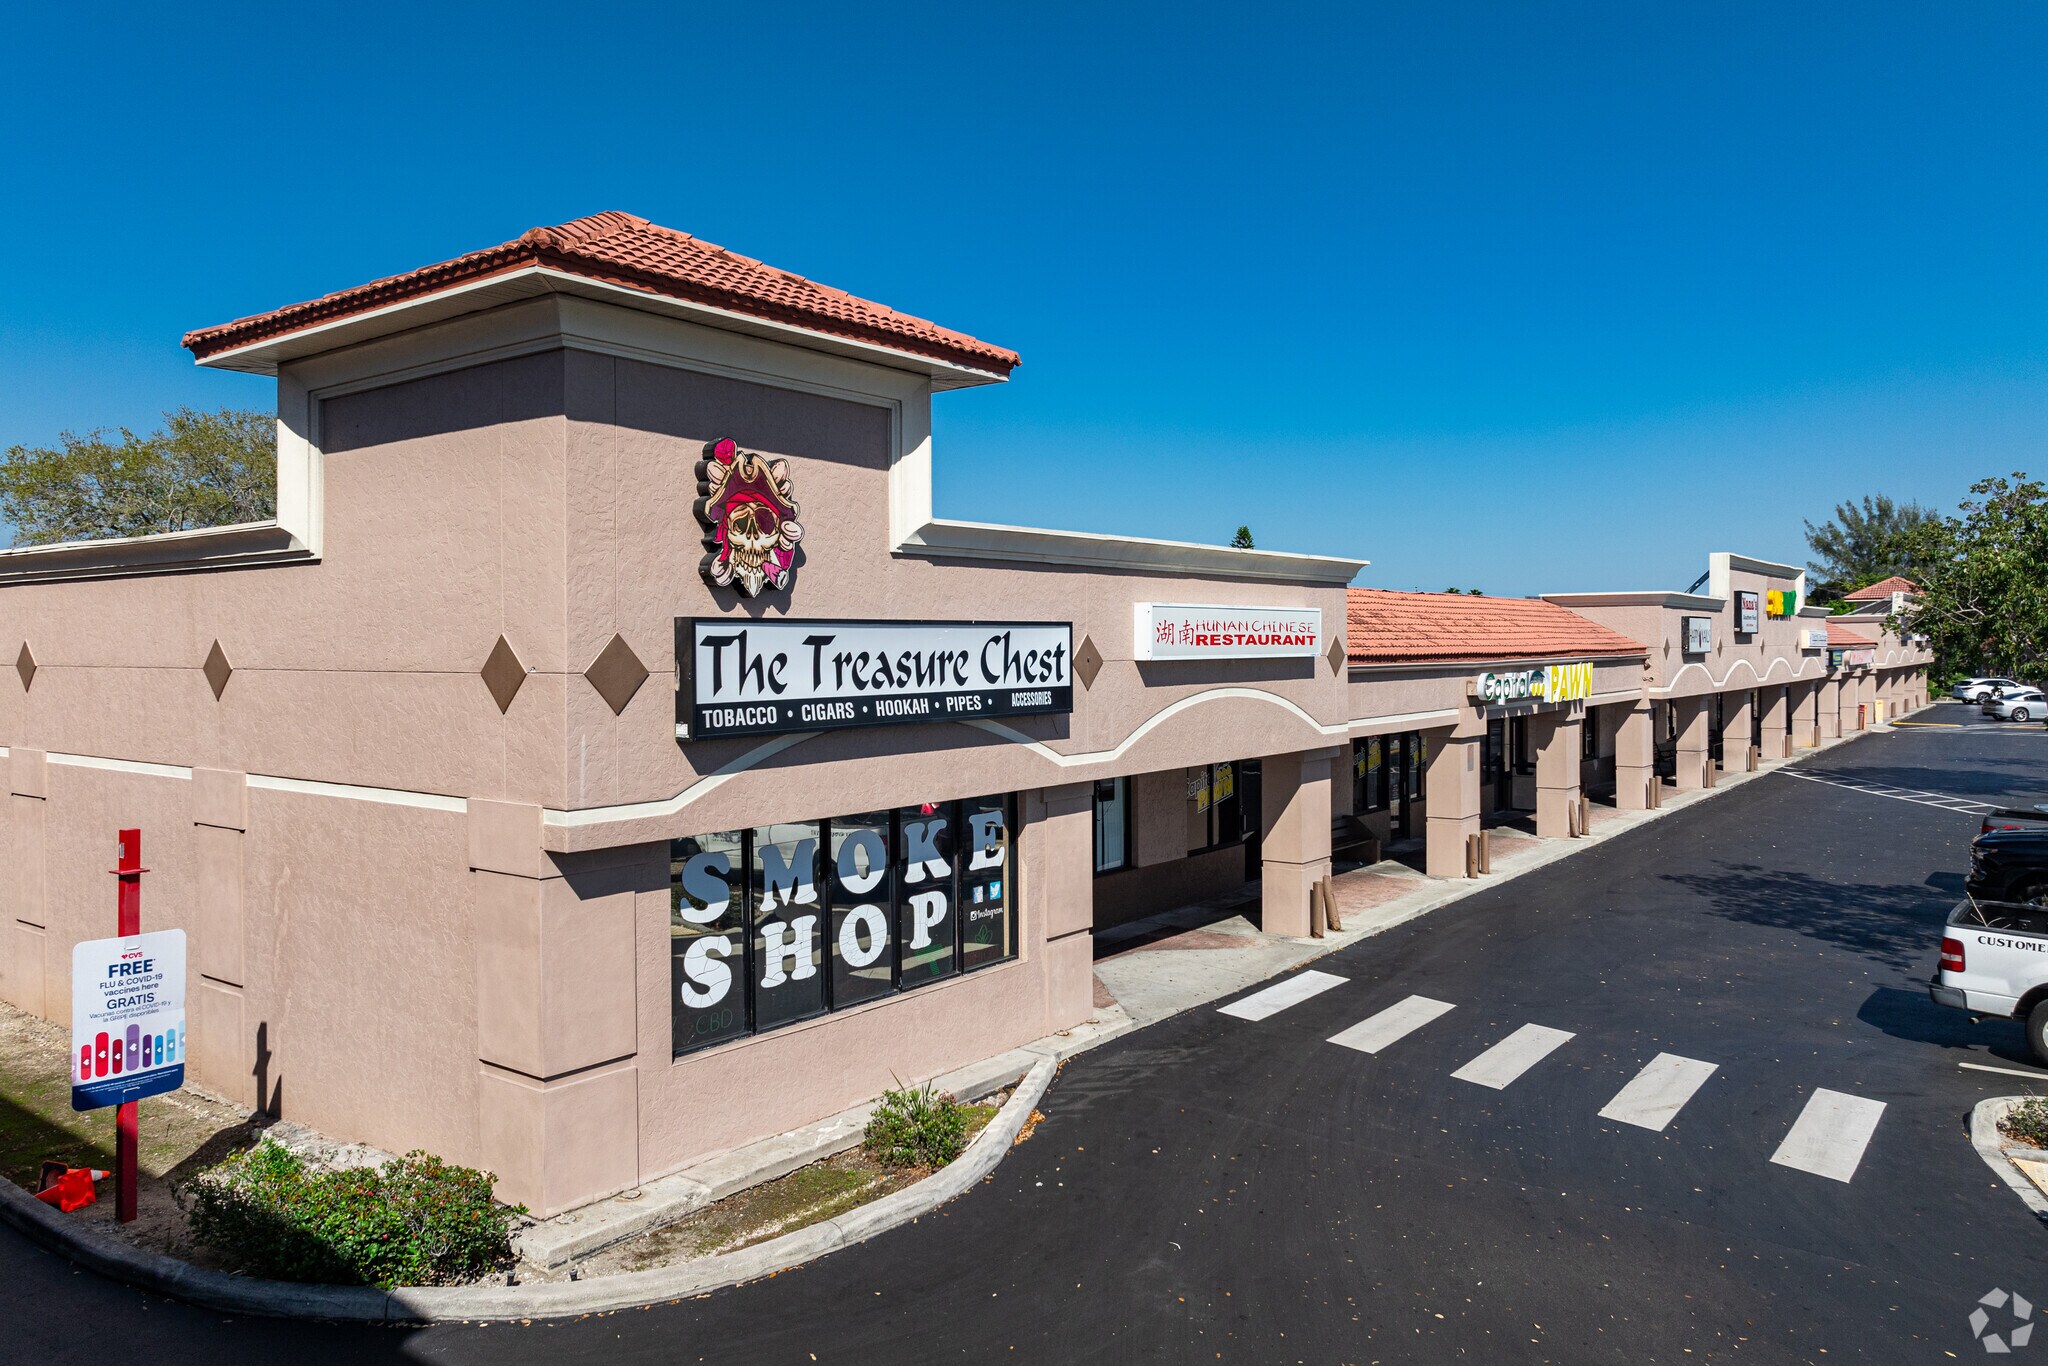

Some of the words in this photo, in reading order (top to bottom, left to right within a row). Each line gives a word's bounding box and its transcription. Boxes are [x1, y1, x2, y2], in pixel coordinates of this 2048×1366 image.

[1156, 619, 1194, 646] 湖南
[1195, 620, 1249, 632] HUNAN
[1251, 621, 1315, 634] CHINESE
[1195, 634, 1316, 646] RESTAURANT
[700, 629, 788, 697] The
[801, 635, 969, 692] Treasure
[980, 631, 1066, 684] Chest
[1547, 662, 1593, 703] PAWN
[702, 706, 778, 728] TOBACCO
[801, 702, 855, 722] CIGARS
[875, 698, 930, 716] HOOKAH
[946, 695, 982, 712] PIPES
[1011, 691, 1052, 707] ACCESSORIES
[680, 810, 1006, 924] SMOKE
[681, 891, 948, 1009] SHOP
[1977, 935, 2048, 953] CUSTOME
[108, 959, 153, 978] FREE
[99, 981, 116, 989] FLU
[126, 973, 163, 985] COVID-19
[104, 987, 140, 996] vaccines
[107, 992, 155, 1009] GRATIS
[696, 1009, 733, 1034] CBD
